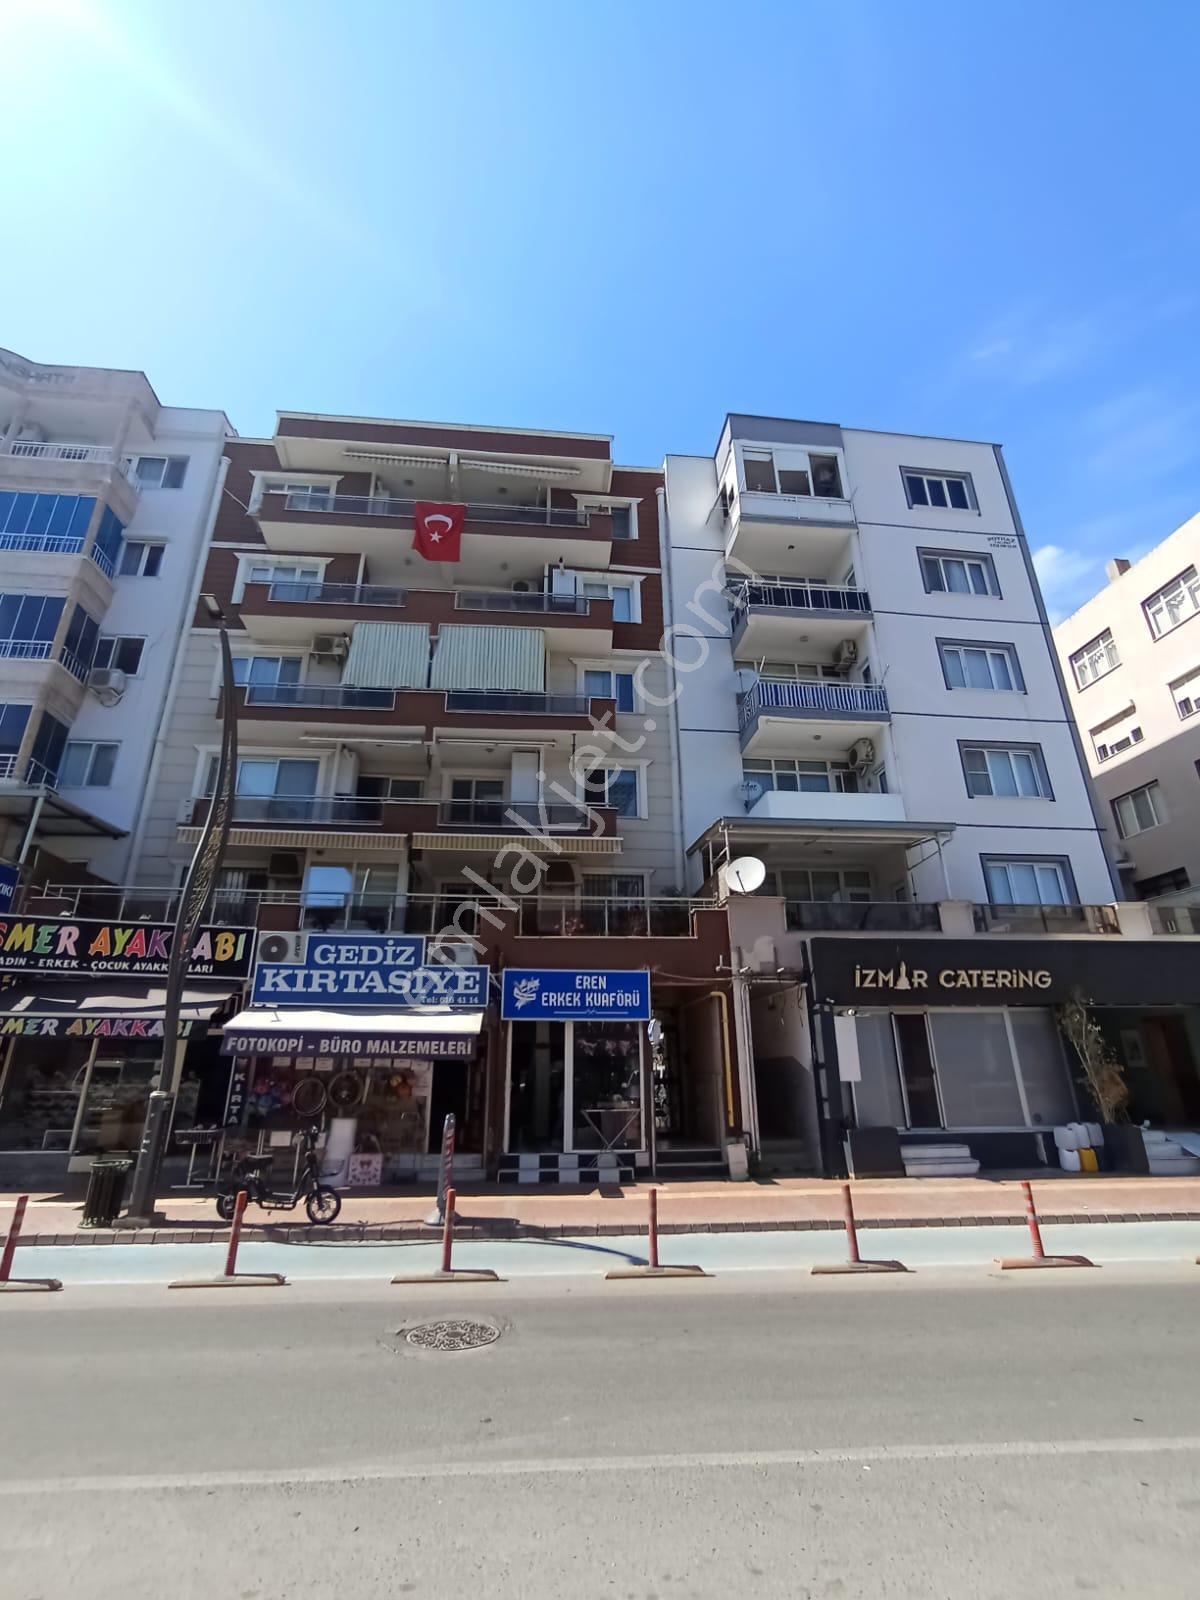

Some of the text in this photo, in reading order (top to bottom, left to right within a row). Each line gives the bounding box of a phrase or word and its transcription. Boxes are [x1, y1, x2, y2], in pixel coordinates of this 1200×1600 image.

[88, 928, 246, 962] AYAKABI
[313, 939, 416, 966] GEDİZ
[38, 959, 79, 969] ERKEK
[91, 960, 129, 972] ÇOCUK
[132, 961, 214, 973] AYAKKLARI
[260, 967, 480, 993] KIRTASİYE
[575, 975, 607, 989] EREN
[541, 990, 640, 1007] ERKEK KUAFÖRÜ
[0, 1019, 59, 1036] MER
[227, 1035, 304, 1053] FOTOKOPİ
[320, 1037, 361, 1054] BÜRO
[366, 1038, 472, 1055] MALZEMELERİ
